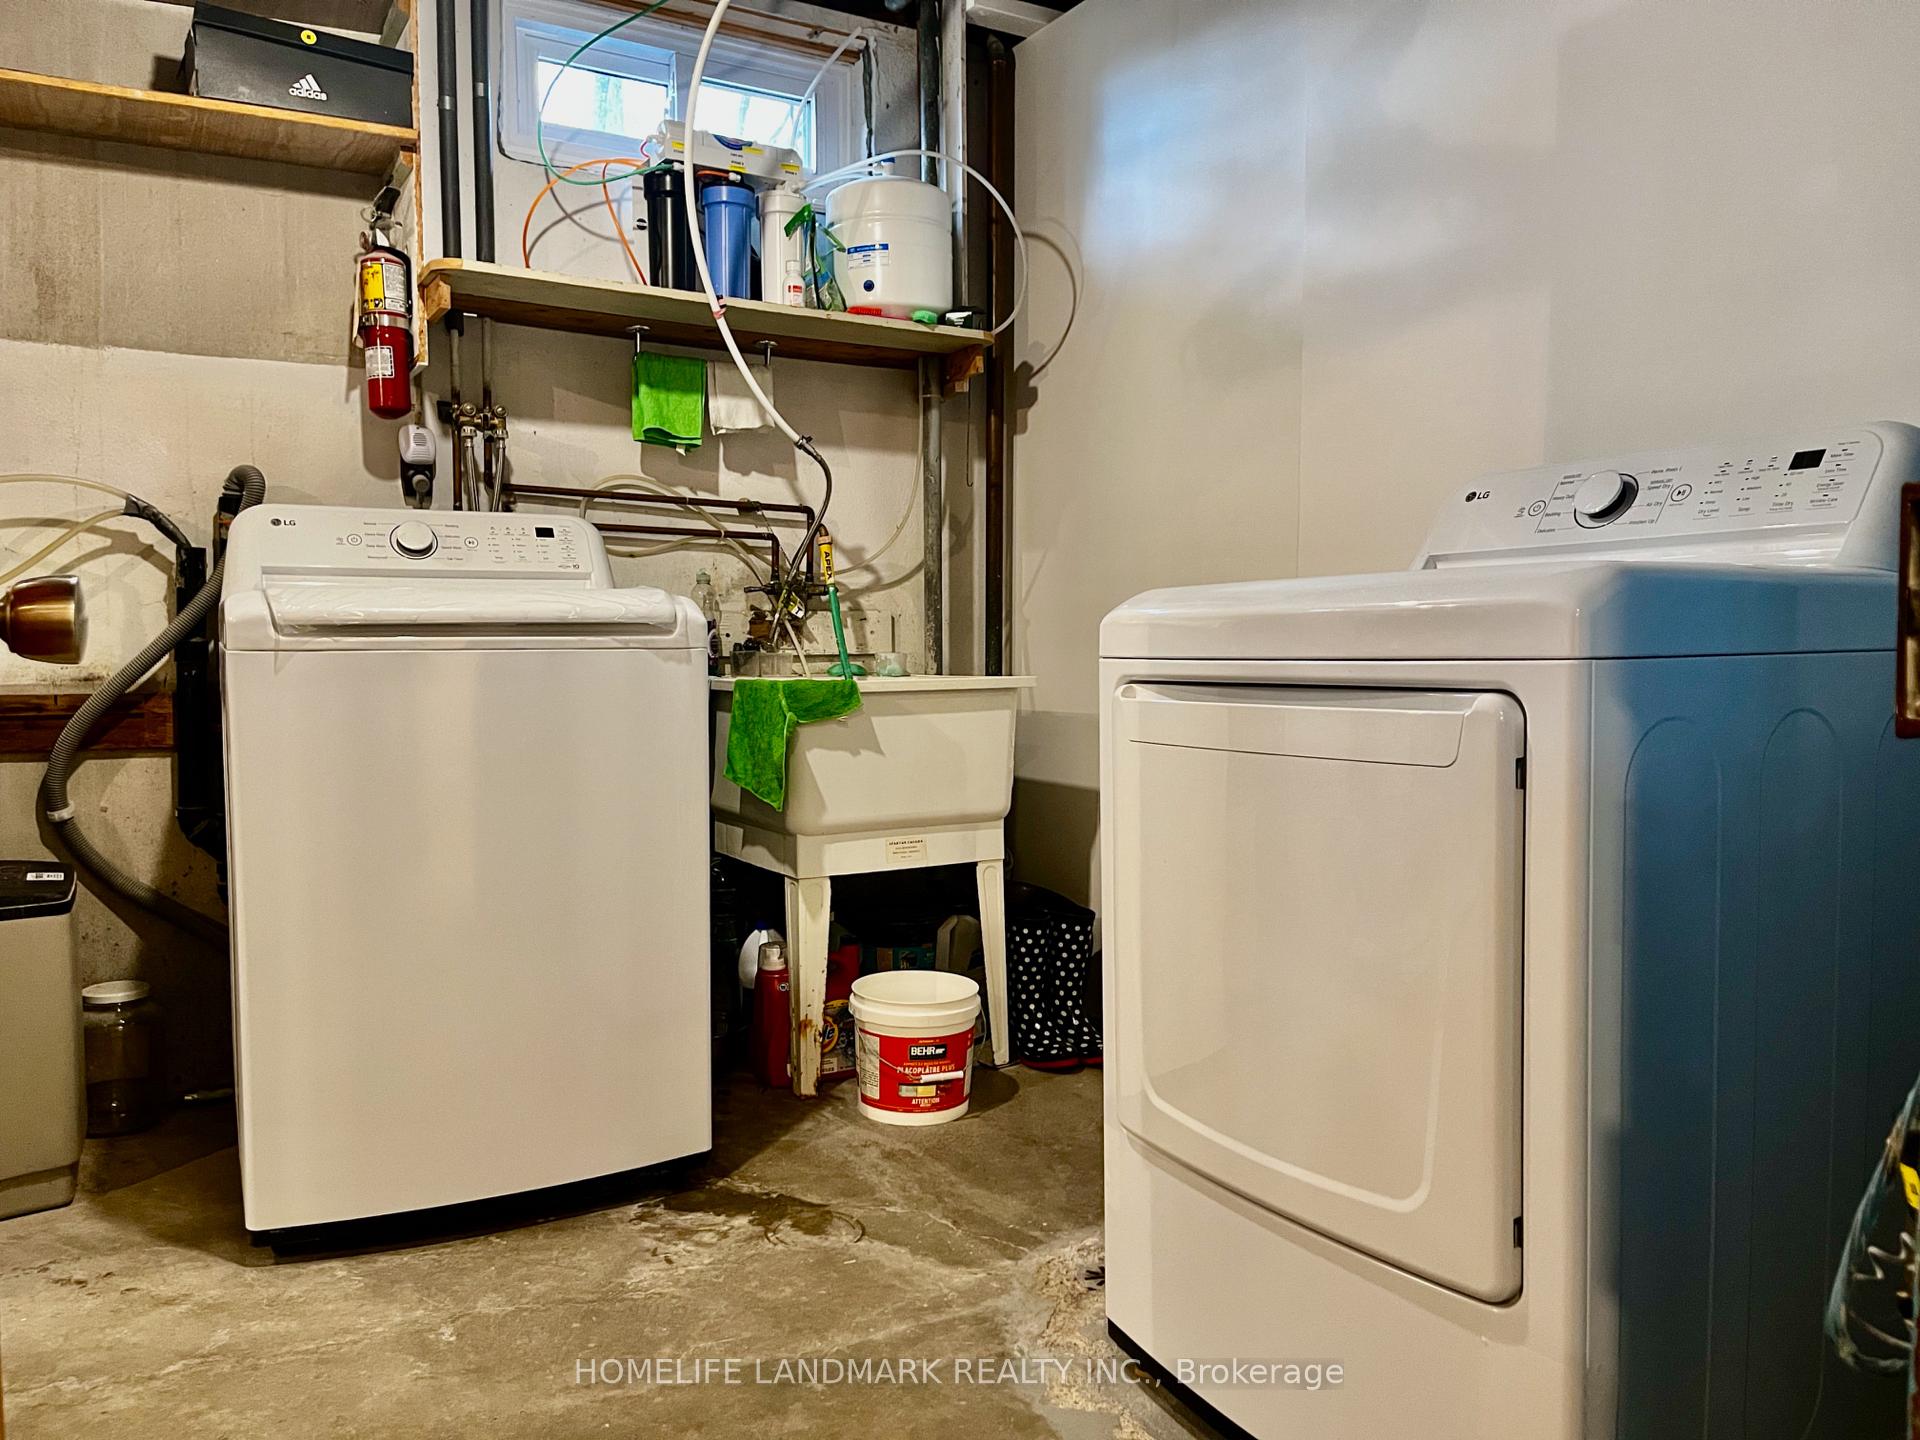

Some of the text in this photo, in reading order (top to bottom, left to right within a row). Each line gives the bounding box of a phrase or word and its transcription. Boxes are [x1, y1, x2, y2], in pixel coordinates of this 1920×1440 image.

[289, 88, 328, 101] adidas
[1477, 491, 1491, 500] LG
[283, 519, 297, 527] LG
[824, 551, 833, 580] APEX
[910, 1046, 936, 1056] BEHR
[911, 1097, 940, 1105] ATTENTION
